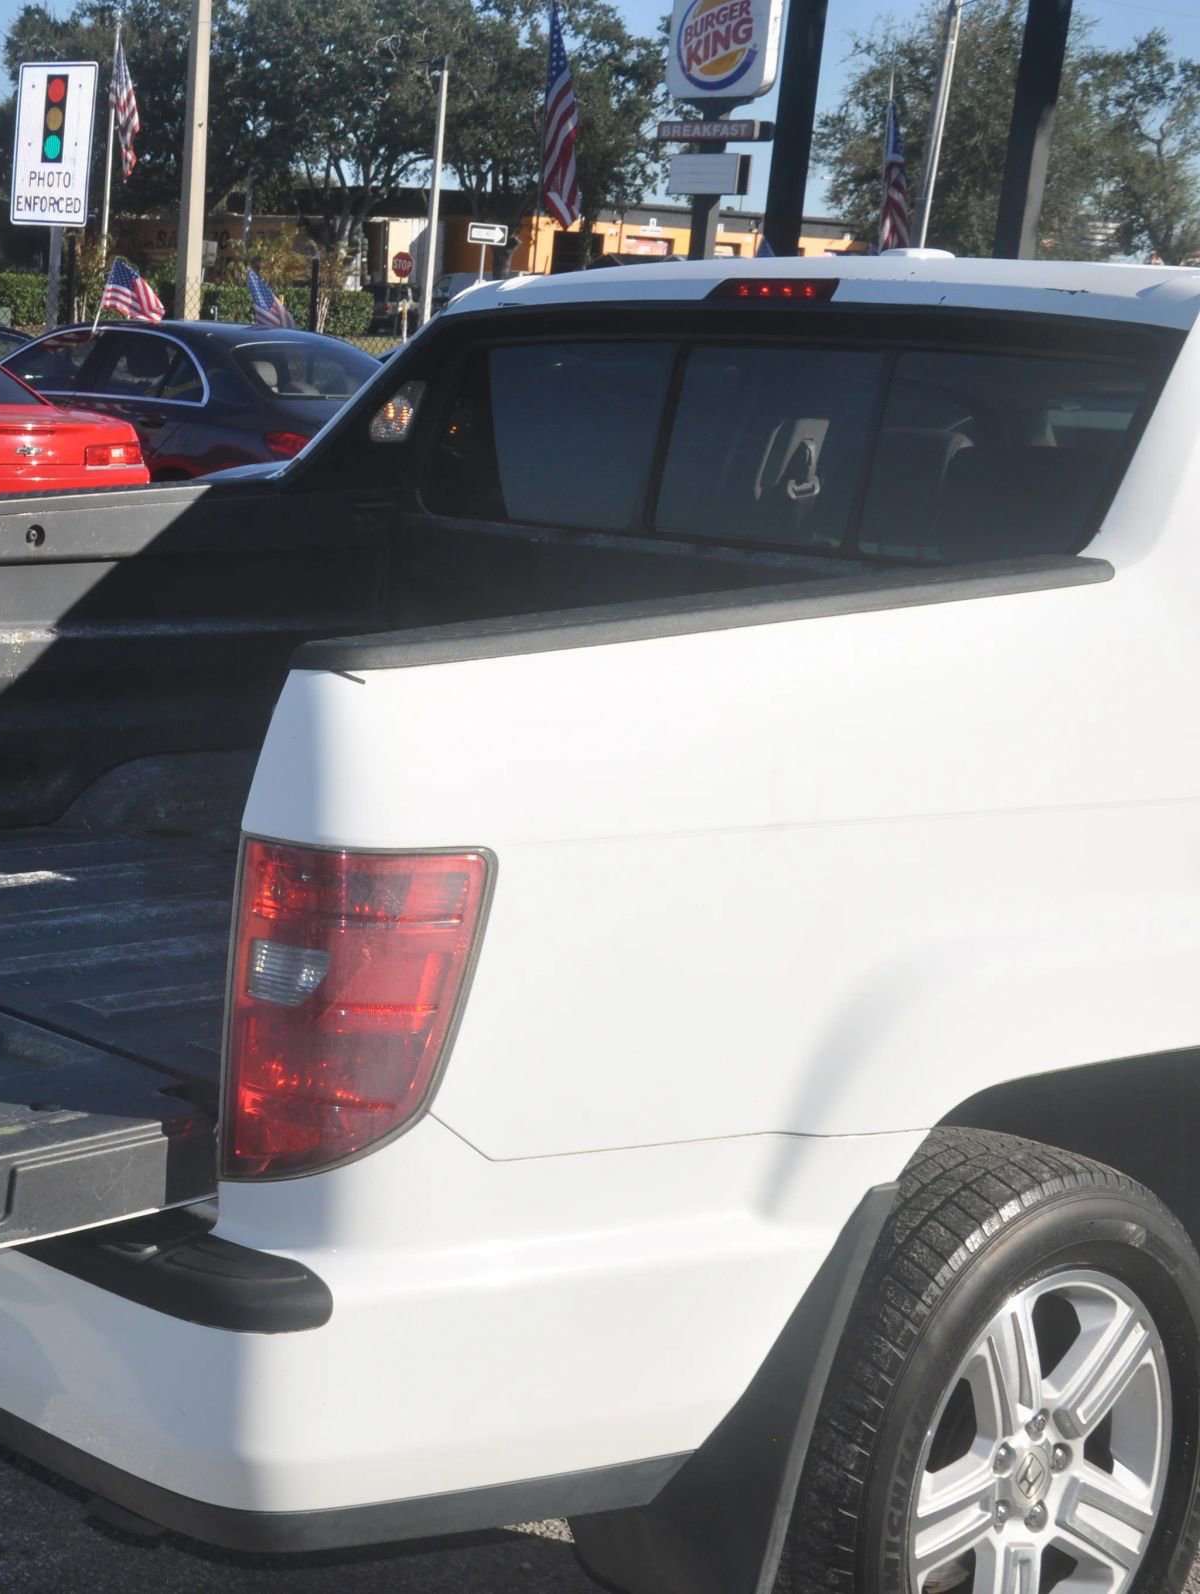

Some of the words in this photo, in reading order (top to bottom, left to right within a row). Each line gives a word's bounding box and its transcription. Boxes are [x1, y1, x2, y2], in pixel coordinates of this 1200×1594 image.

[685, 0, 752, 46] BURGER
[686, 17, 754, 73] KING
[662, 124, 749, 137] BREAKFAST
[29, 171, 72, 188] PHOTO
[16, 196, 81, 213] ENFORCED
[393, 259, 412, 270] STOP
